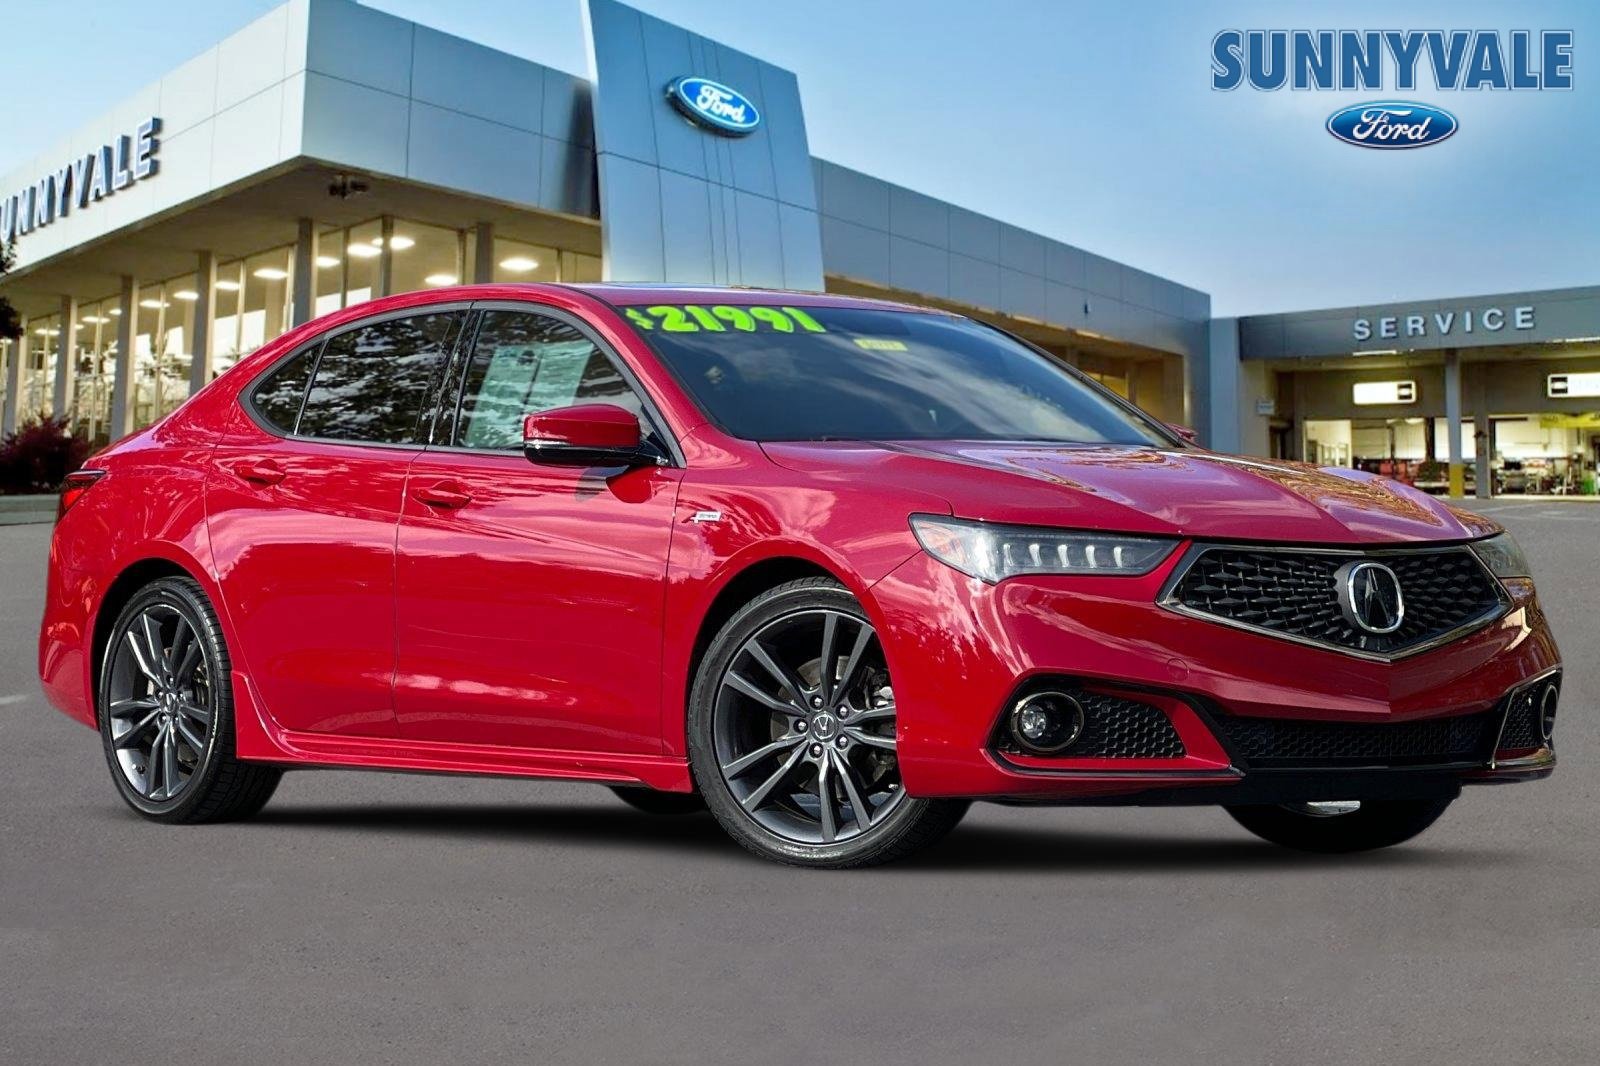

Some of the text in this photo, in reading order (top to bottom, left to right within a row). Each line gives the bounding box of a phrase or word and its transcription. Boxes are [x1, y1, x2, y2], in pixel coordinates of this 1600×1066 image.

[697, 84, 746, 123] Ford
[0, 117, 162, 243] UNNYVALE
[625, 305, 827, 333] $21991
[1353, 305, 1536, 341] SERVICE
